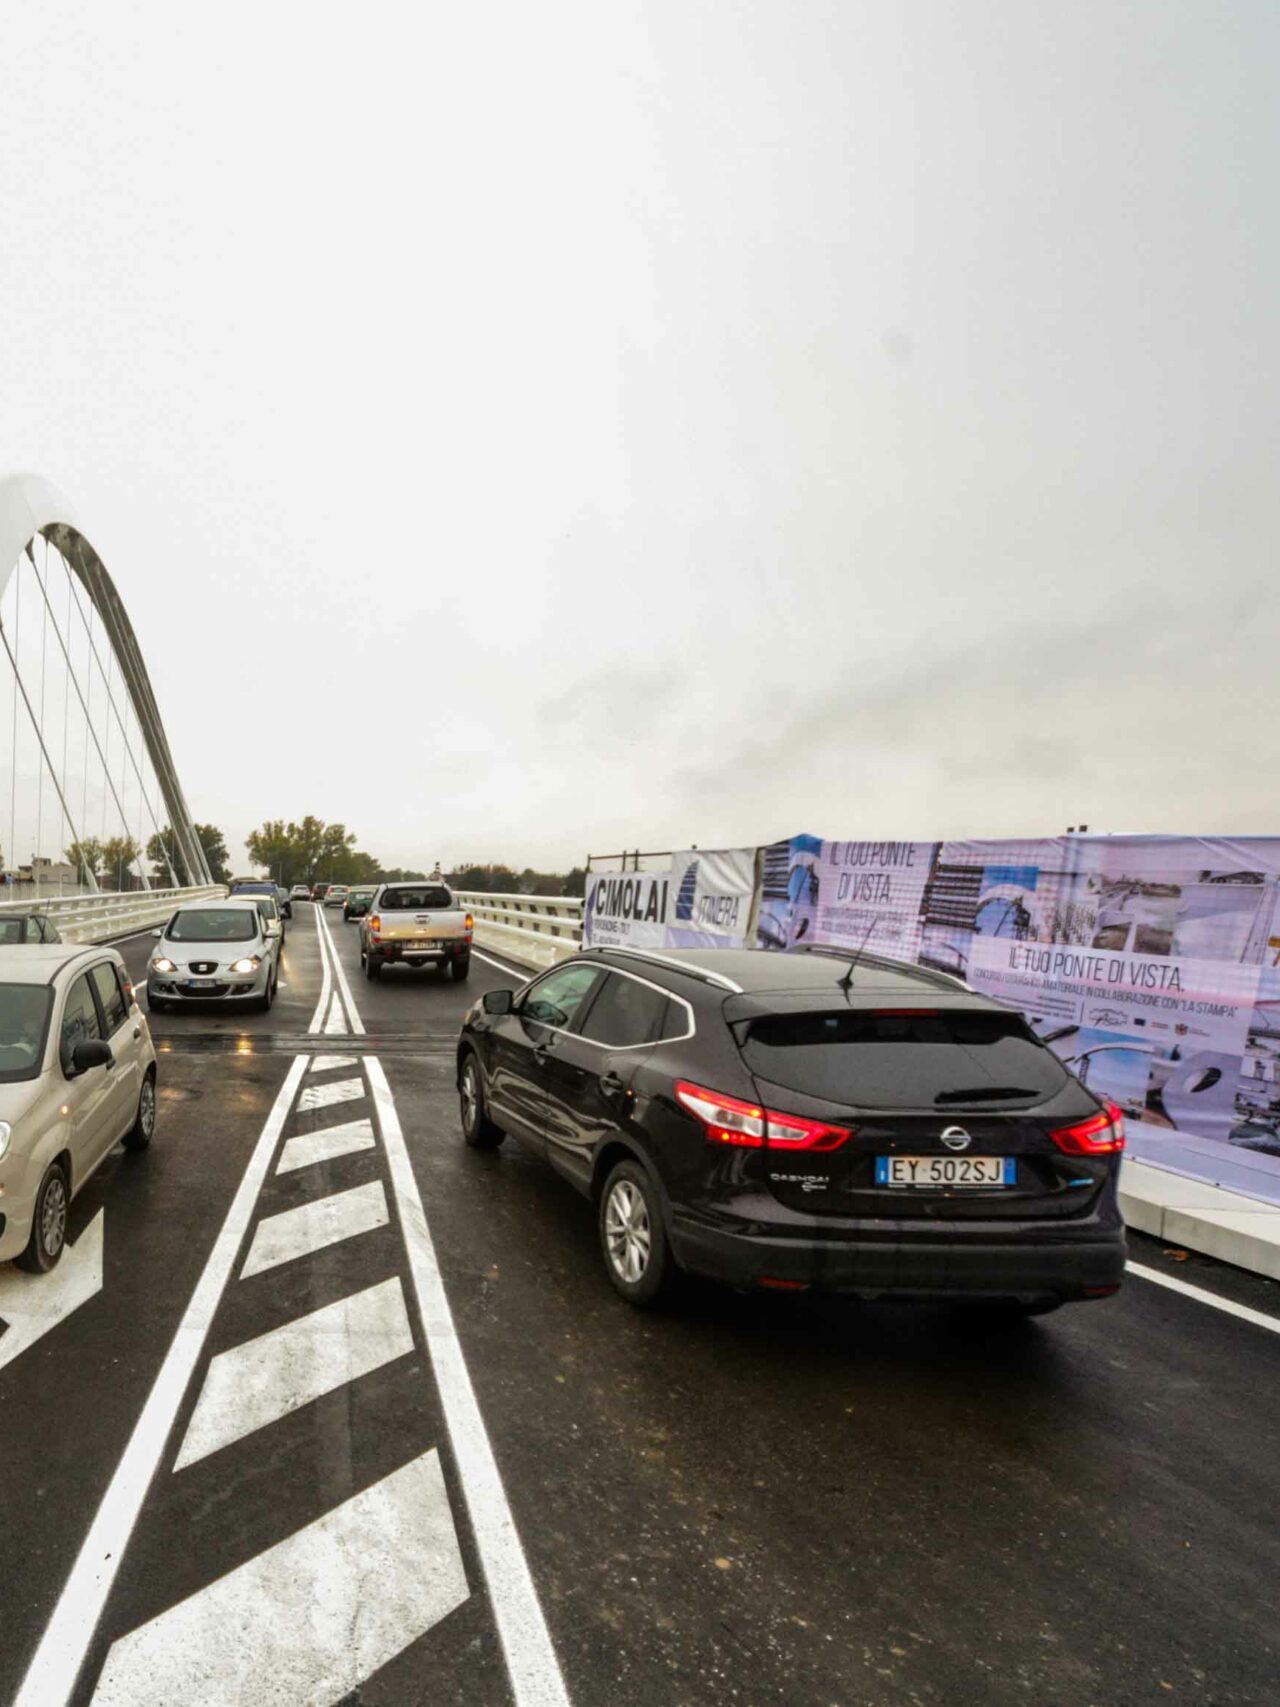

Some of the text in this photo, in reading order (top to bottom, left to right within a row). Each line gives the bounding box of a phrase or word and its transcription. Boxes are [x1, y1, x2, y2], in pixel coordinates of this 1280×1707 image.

[595, 878, 669, 924] CIMOLAI
[838, 872, 852, 900] DI
[698, 895, 740, 927] ITINERA
[1009, 946, 1185, 993] IL TUO PONTE DI VISTA.
[1093, 988, 1161, 1007] COLLABORAZIONE
[1161, 996, 1177, 1010] CON
[892, 1159, 1001, 1182] EY 502SJ
